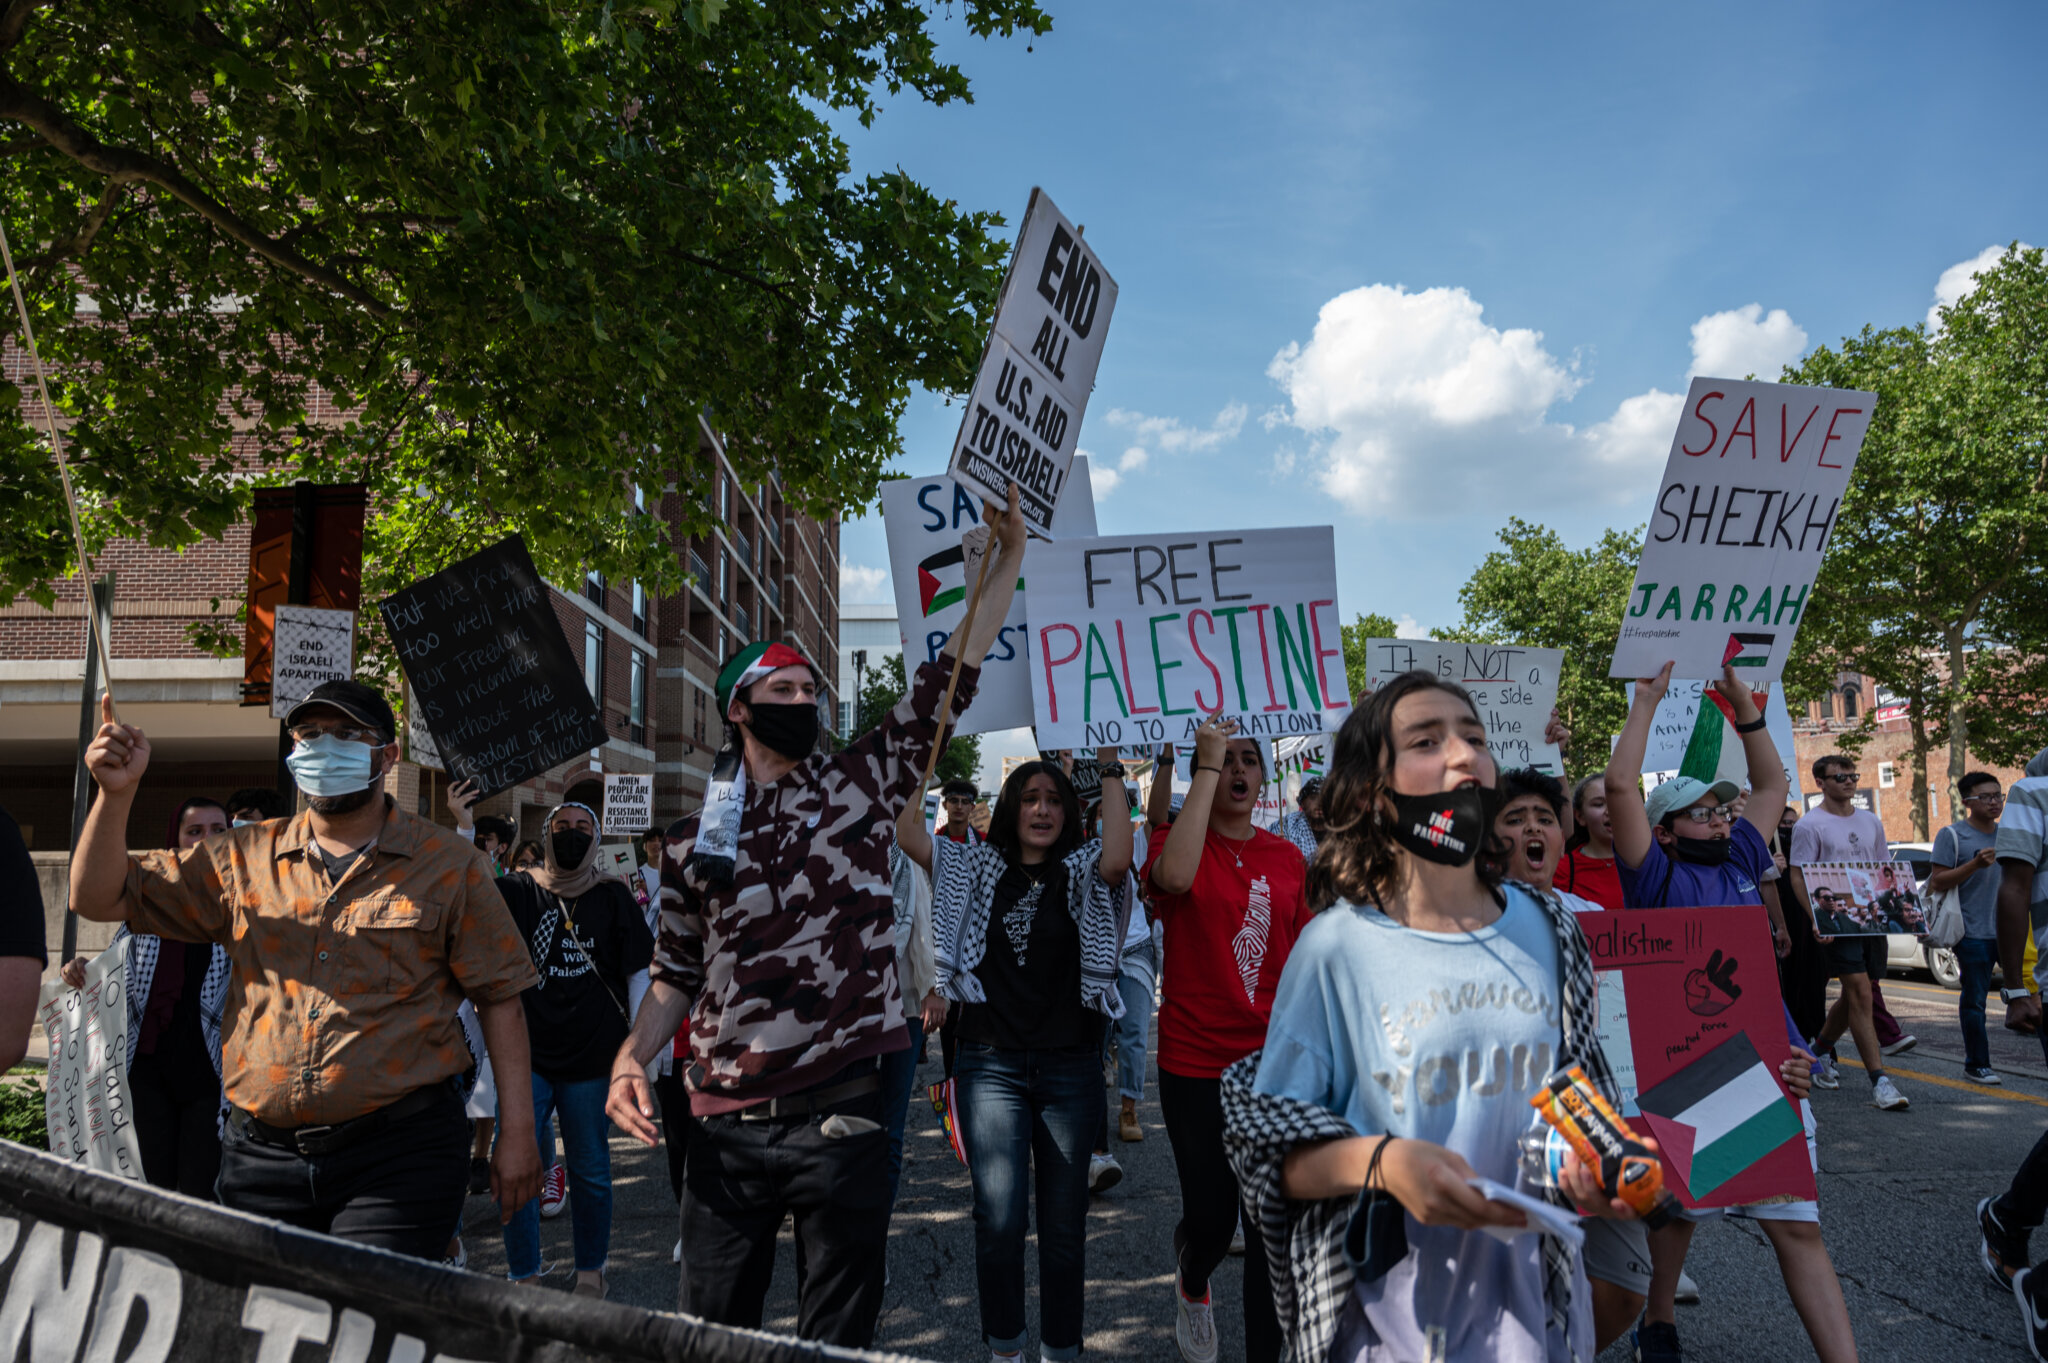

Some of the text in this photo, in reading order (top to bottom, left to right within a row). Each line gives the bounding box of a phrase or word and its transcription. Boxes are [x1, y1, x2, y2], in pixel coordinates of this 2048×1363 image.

[1036, 222, 1101, 340] END
[1031, 315, 1070, 383] ALL
[995, 357, 1068, 453] U.S. AID
[1682, 391, 1863, 469] SAVE
[969, 404, 1063, 506] TO ISRAEL!
[917, 482, 986, 532] SA
[967, 455, 1046, 525] ANSWERcotion.org
[1654, 483, 1840, 551] SHEIKH
[1084, 538, 1253, 609] FREE
[402, 578, 540, 660] too well that
[1629, 583, 1809, 626] JARRAH
[289, 654, 333, 667] ISRAELI
[299, 640, 323, 650] END
[1040, 600, 1348, 723] PALESTINE
[1378, 645, 1543, 686] It is NOT a
[279, 668, 345, 681] APARTHEID
[1466, 685, 1534, 706] ne side
[520, 683, 555, 711] the
[1085, 712, 1323, 747] NO TO AXATION!
[1485, 710, 1522, 734] the
[608, 785, 649, 795] PEOPLE ARE
[610, 794, 646, 805] OCCUPIED,
[618, 776, 640, 785] WHEN
[605, 816, 649, 827] IS JUSTIFIED!
[607, 807, 647, 816] RESISTANCE
[1428, 810, 1455, 834] FREE
[1412, 822, 1466, 853] PALESTINE
[105, 1033, 130, 1135] Stand
[1371, 1042, 1553, 1116] YOUN
[64, 1067, 88, 1162] Stand
